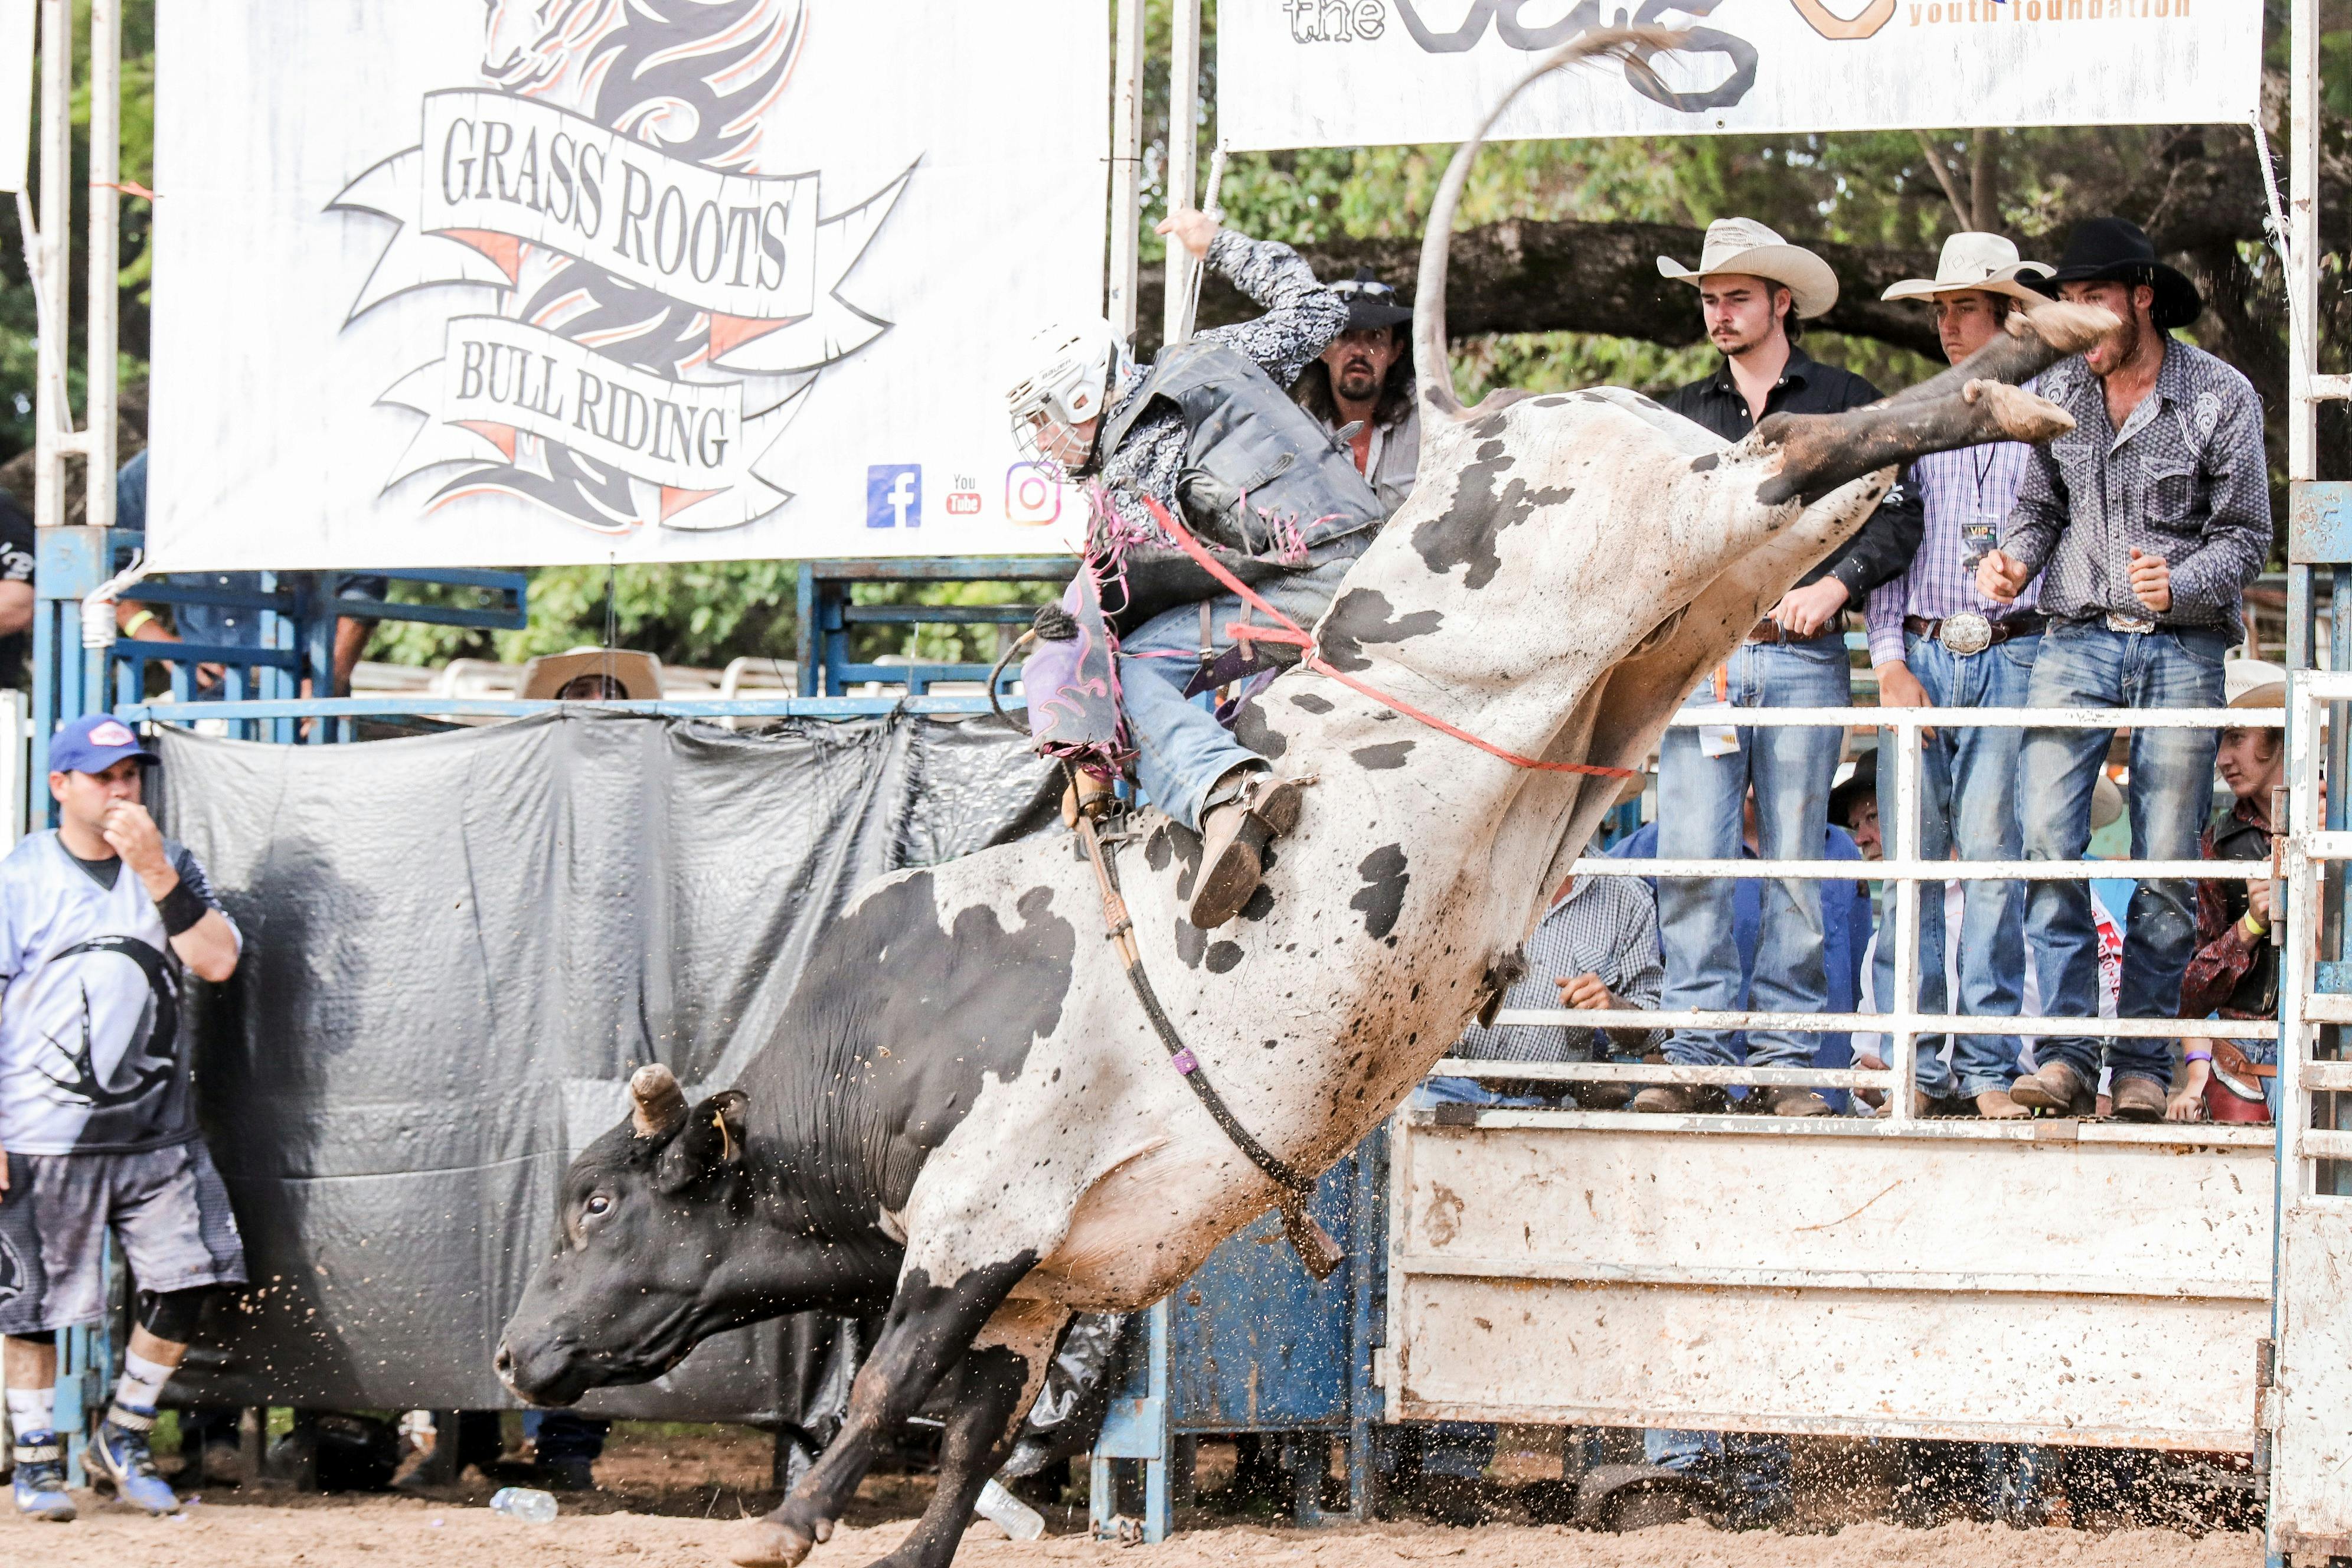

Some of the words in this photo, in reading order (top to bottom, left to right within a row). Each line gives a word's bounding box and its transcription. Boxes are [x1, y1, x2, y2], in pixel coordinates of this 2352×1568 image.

[1282, 0, 1386, 44] the
[1909, 0, 1998, 27] youth
[2013, 0, 2190, 22] foundation
[442, 117, 606, 240] GRASS
[612, 159, 789, 292] ROOTS
[456, 341, 563, 420] BULL
[571, 368, 729, 469] RIDING
[953, 473, 976, 490] You
[949, 495, 978, 512] Tube
[1970, 526, 1988, 535] VIP
